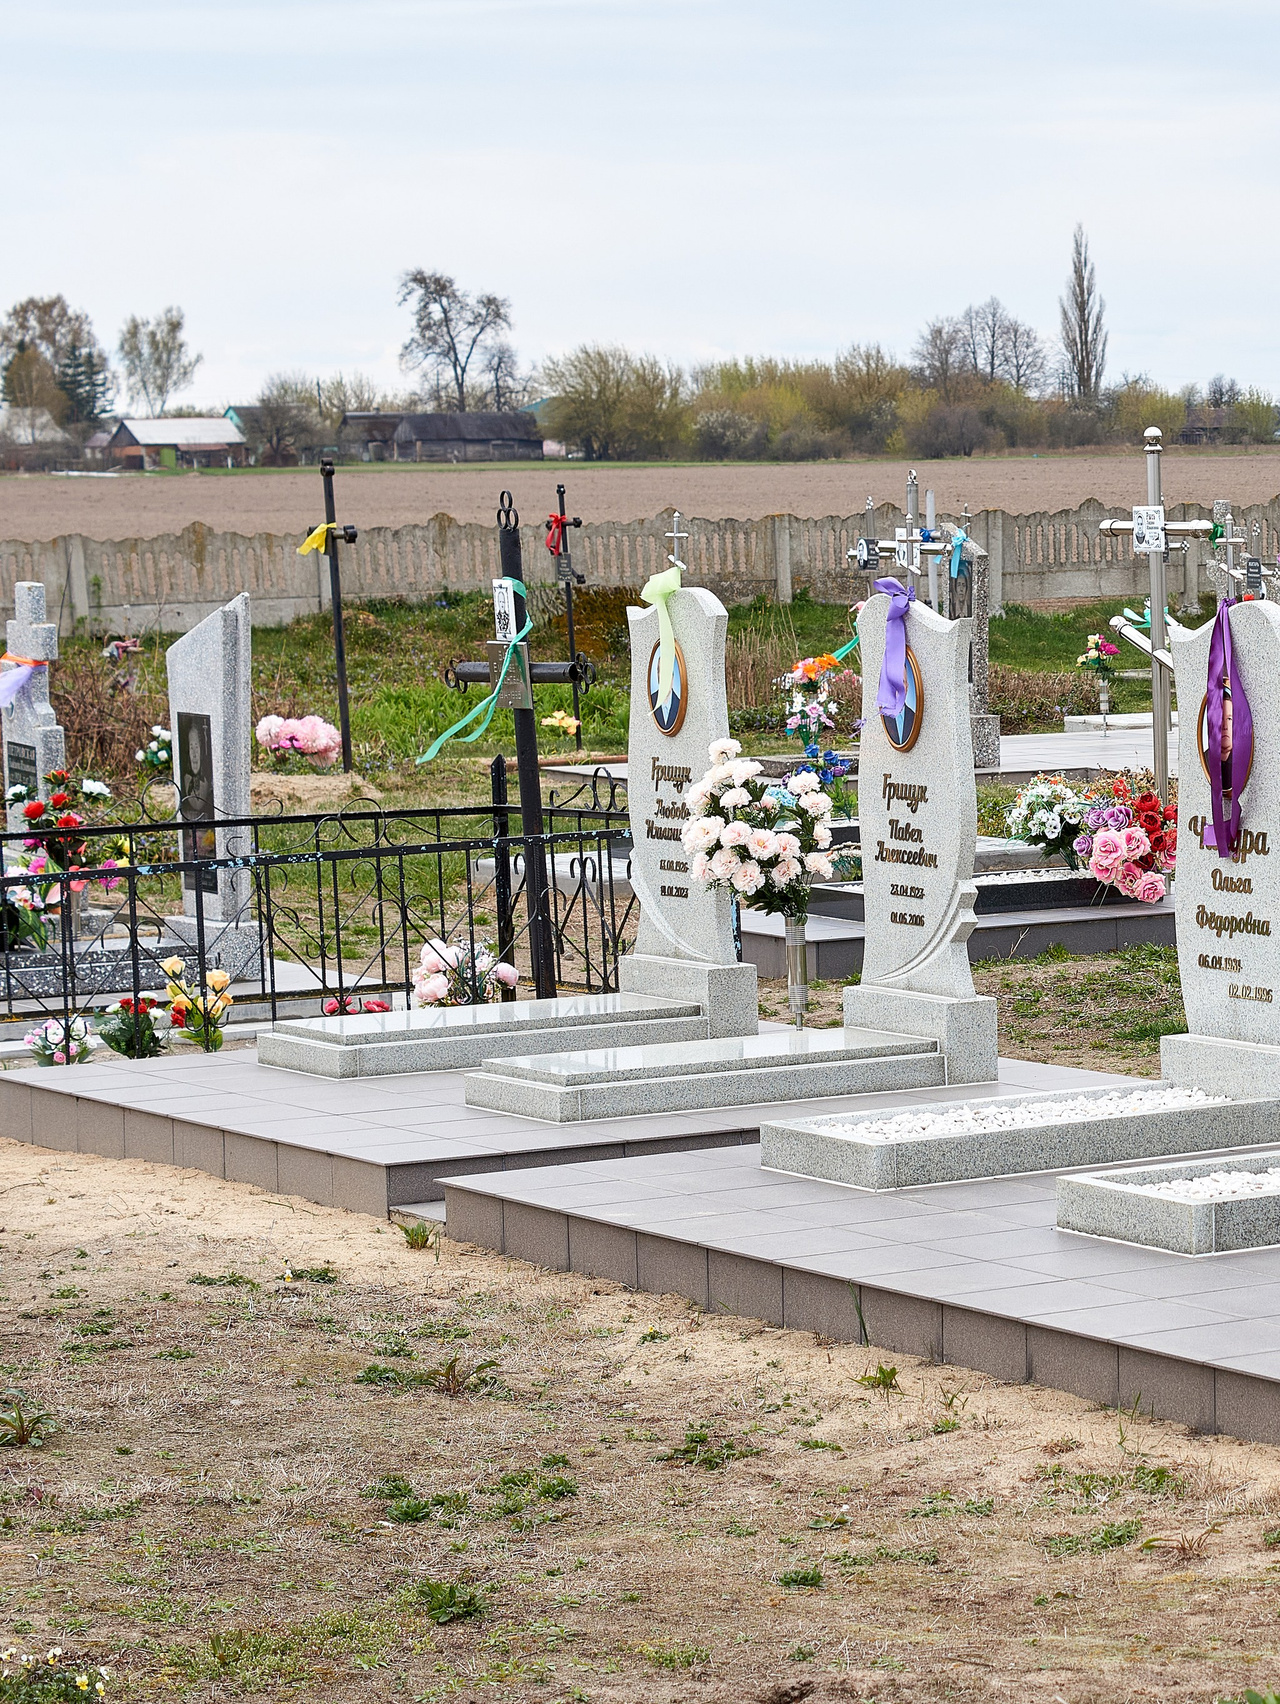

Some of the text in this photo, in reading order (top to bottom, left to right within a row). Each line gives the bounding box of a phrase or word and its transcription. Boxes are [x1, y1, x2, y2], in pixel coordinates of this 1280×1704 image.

[889, 819, 923, 844] Павел
[1188, 815, 1270, 864] Чура
[875, 840, 938, 868] Алексеевич
[1211, 868, 1254, 894] Ольга
